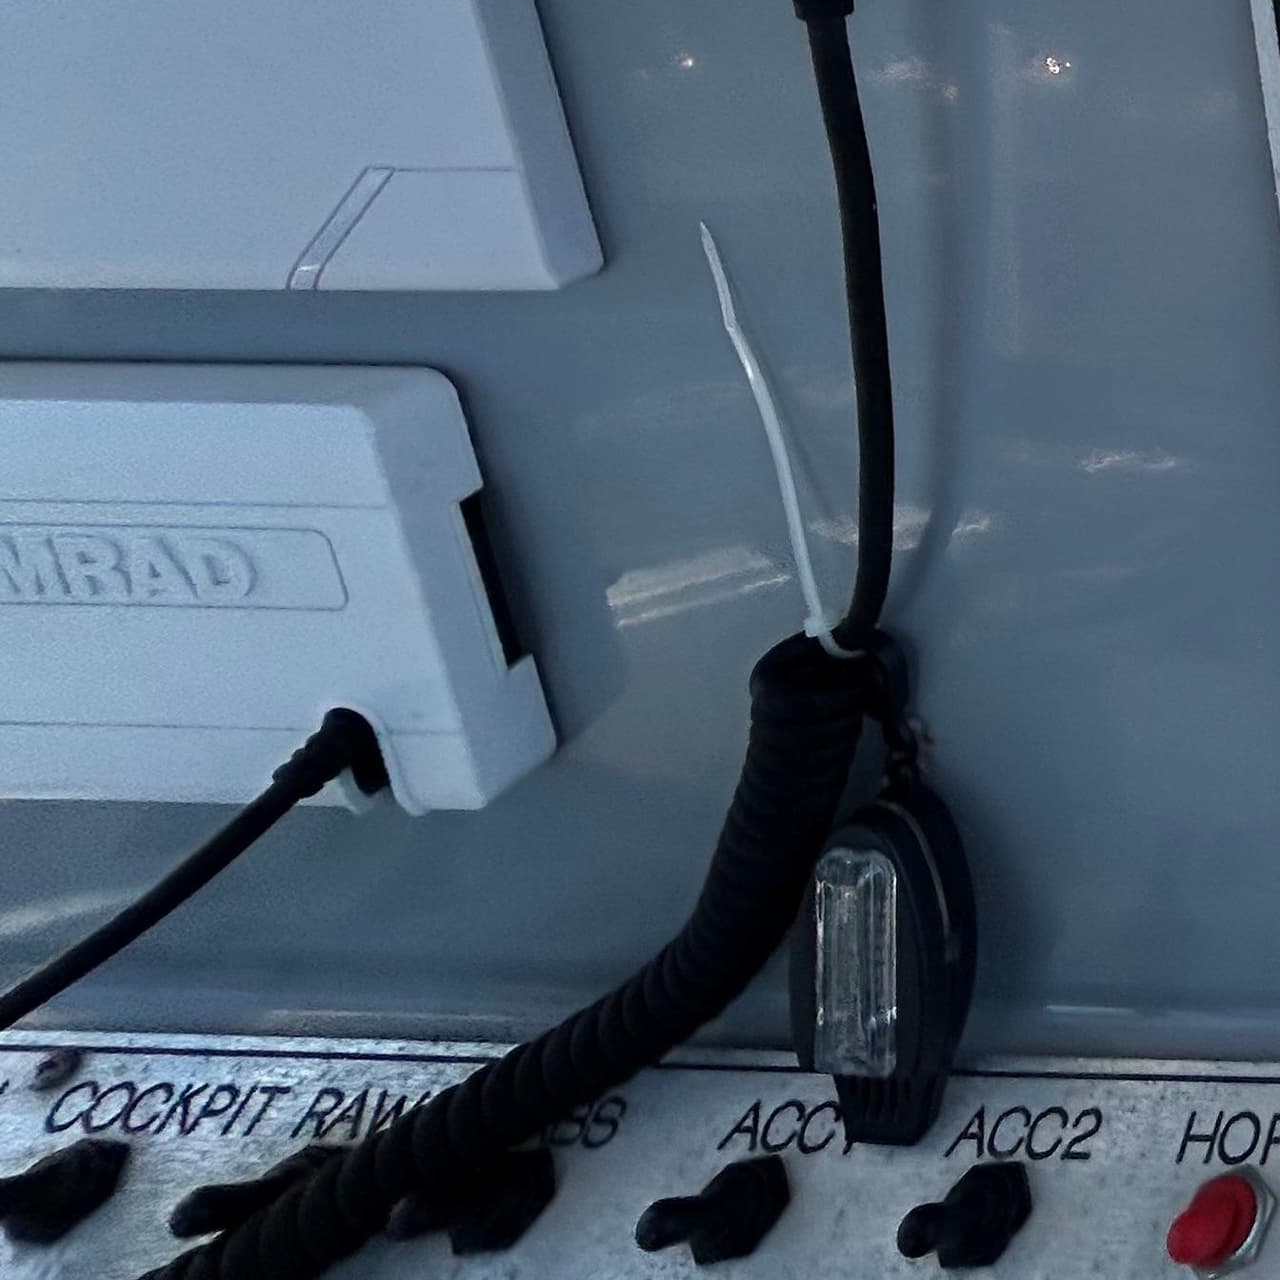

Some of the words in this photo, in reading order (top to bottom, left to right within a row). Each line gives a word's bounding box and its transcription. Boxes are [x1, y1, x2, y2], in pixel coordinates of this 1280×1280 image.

[45, 1081, 290, 1139] COCKPIT
[716, 1099, 855, 1157] ACC
[944, 1104, 1103, 1160] ACC2
